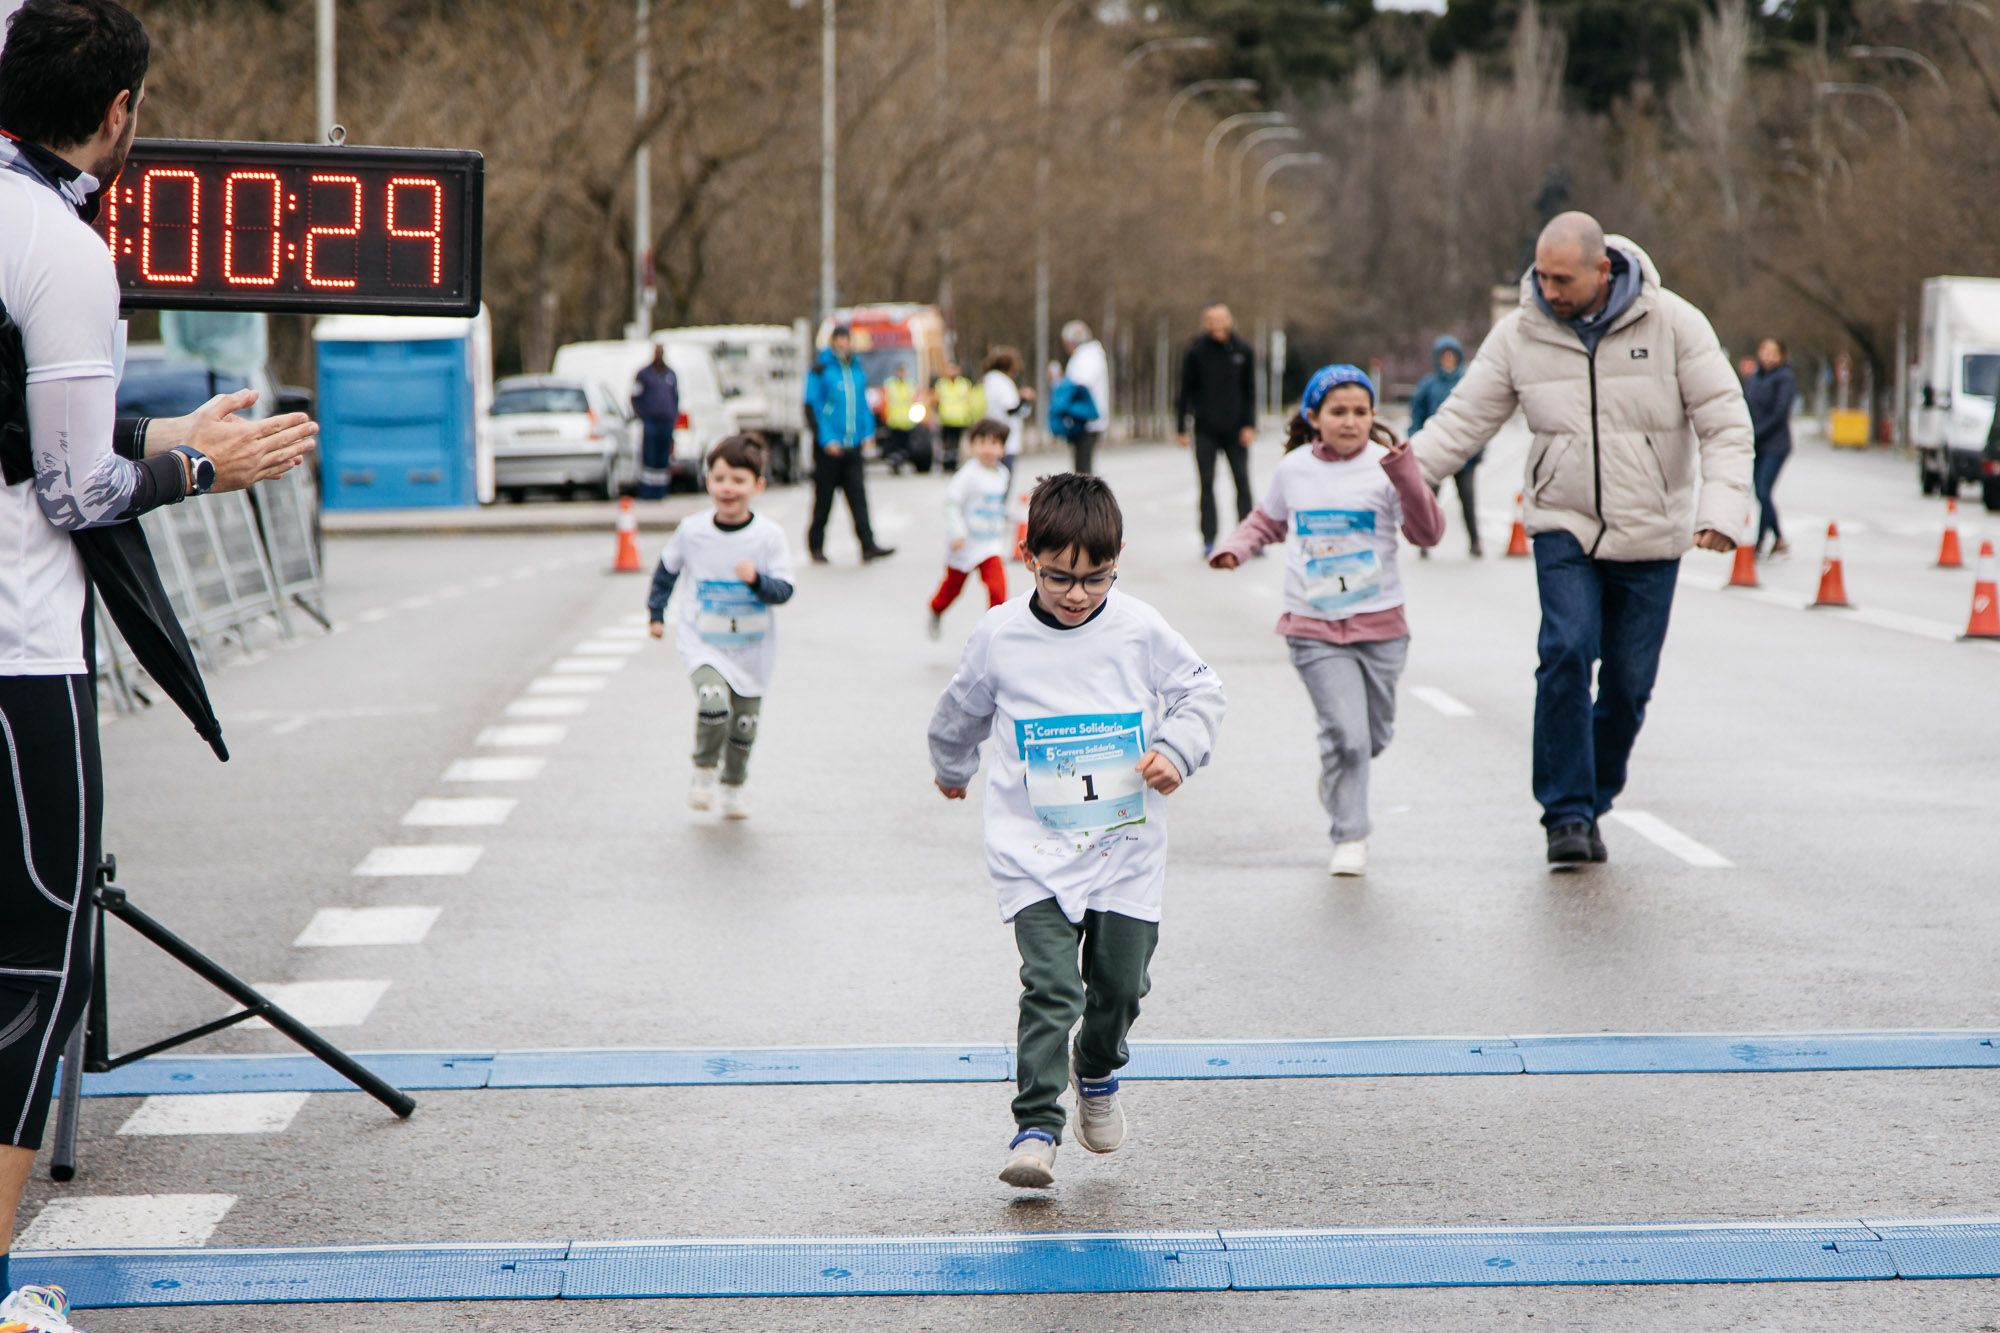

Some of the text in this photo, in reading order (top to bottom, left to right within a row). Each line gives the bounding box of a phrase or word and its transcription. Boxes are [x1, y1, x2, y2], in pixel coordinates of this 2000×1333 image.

[1339, 576, 1348, 592] 1
[1037, 725, 1076, 736] Carrera
[1056, 748, 1084, 757] Carrera
[1081, 774, 1099, 802] 1
